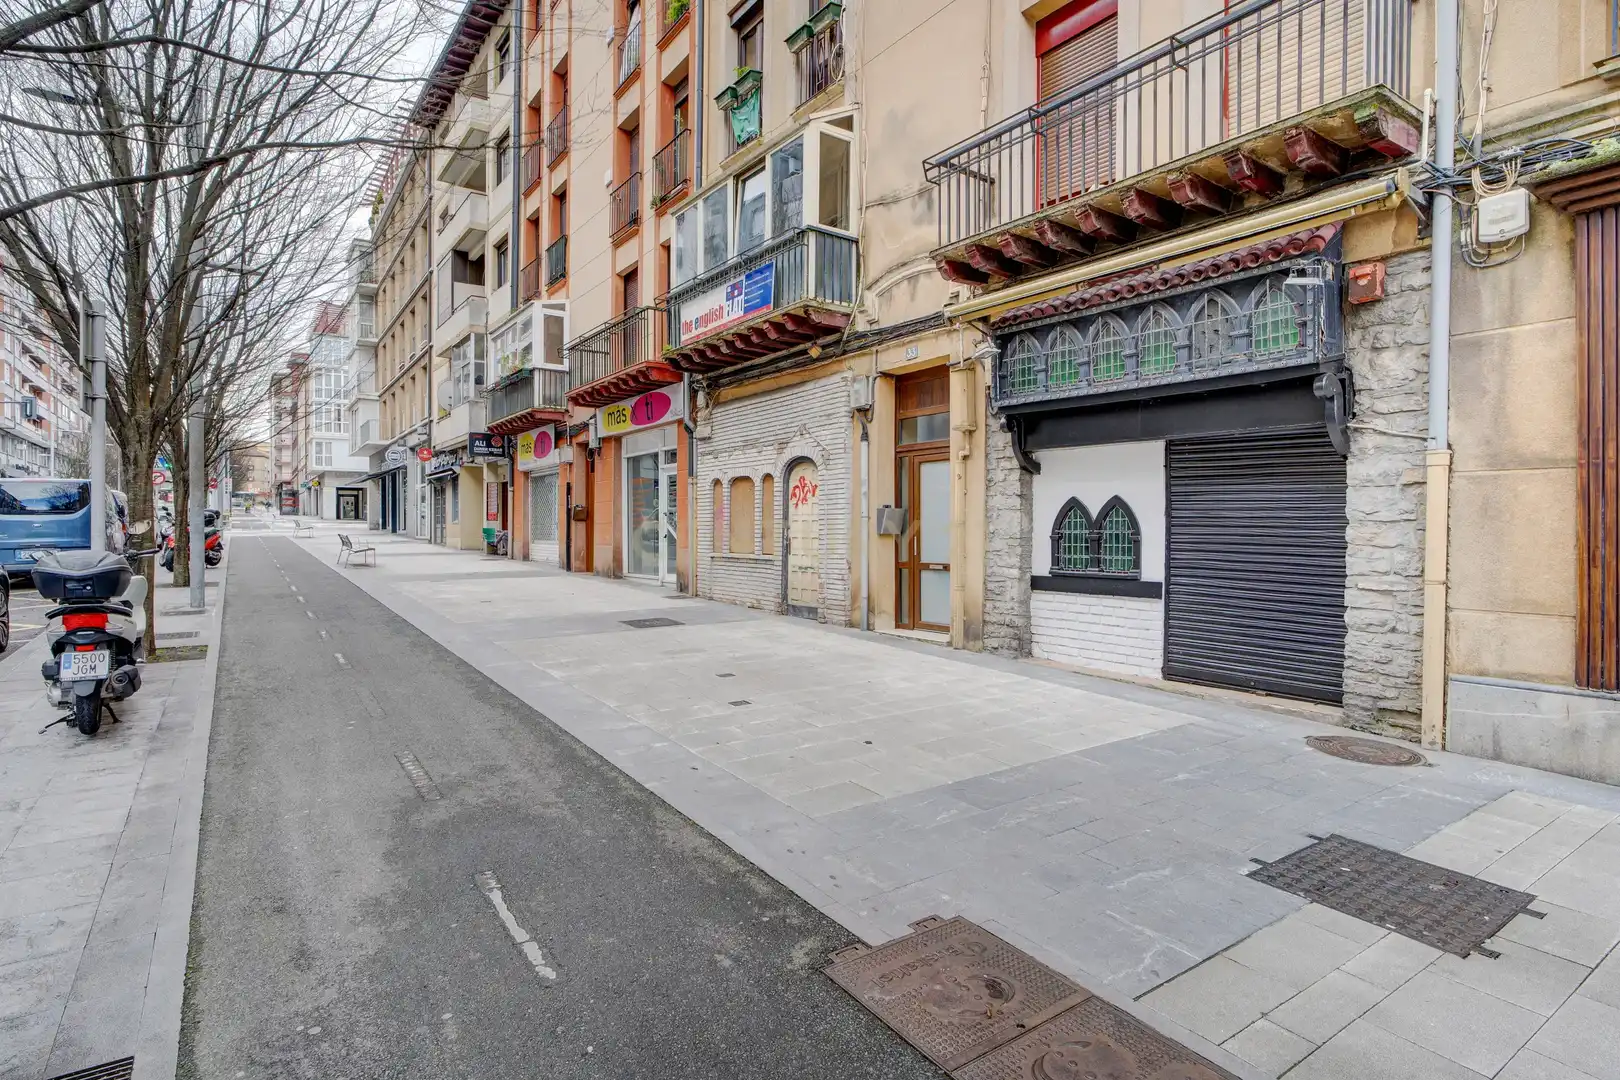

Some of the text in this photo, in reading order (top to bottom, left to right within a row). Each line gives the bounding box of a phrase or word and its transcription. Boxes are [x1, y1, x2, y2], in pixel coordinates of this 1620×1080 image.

[681, 319, 693, 336] the
[694, 304, 724, 330] english
[906, 347, 916, 358] 33
[607, 405, 627, 427] más
[645, 393, 653, 420] ti
[73, 653, 105, 664] 5500
[72, 664, 97, 675] JGM
